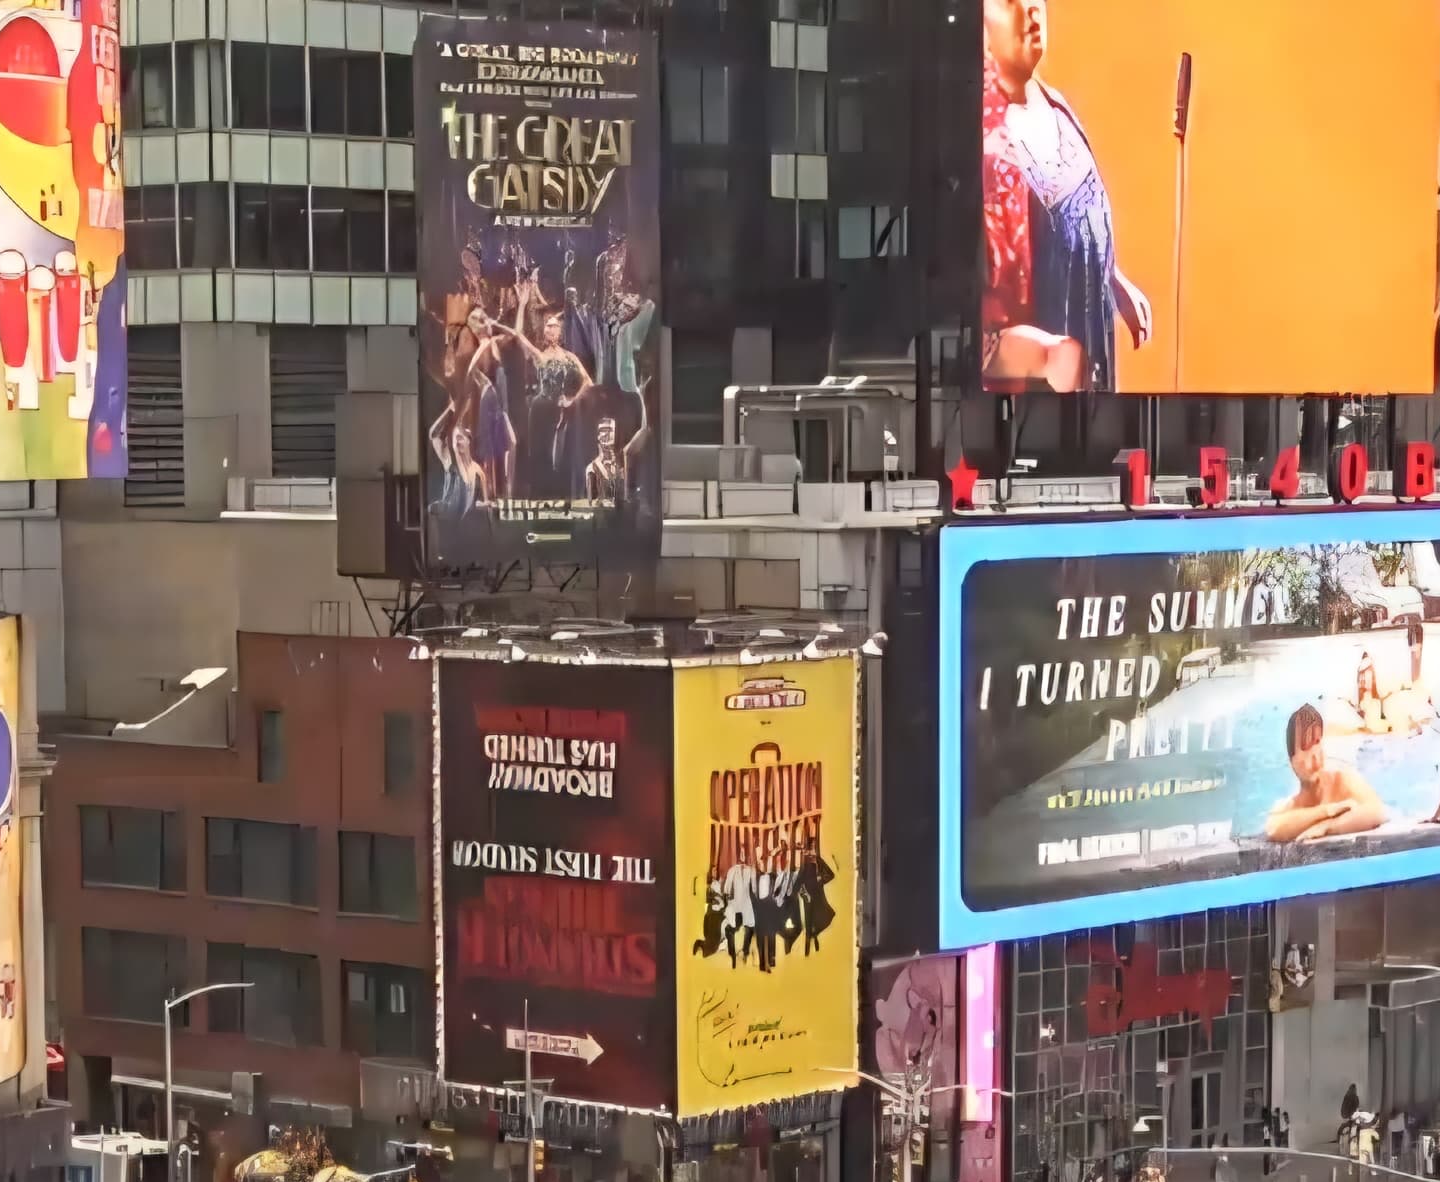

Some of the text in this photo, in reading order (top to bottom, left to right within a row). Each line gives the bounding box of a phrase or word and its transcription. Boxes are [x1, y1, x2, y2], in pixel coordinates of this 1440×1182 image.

[442, 104, 636, 166] THE GREAT
[468, 164, 616, 214] GATSBY
[1122, 443, 1368, 508] 1540
[1056, 595, 1127, 640] THE
[980, 655, 1162, 710] I TURNED
